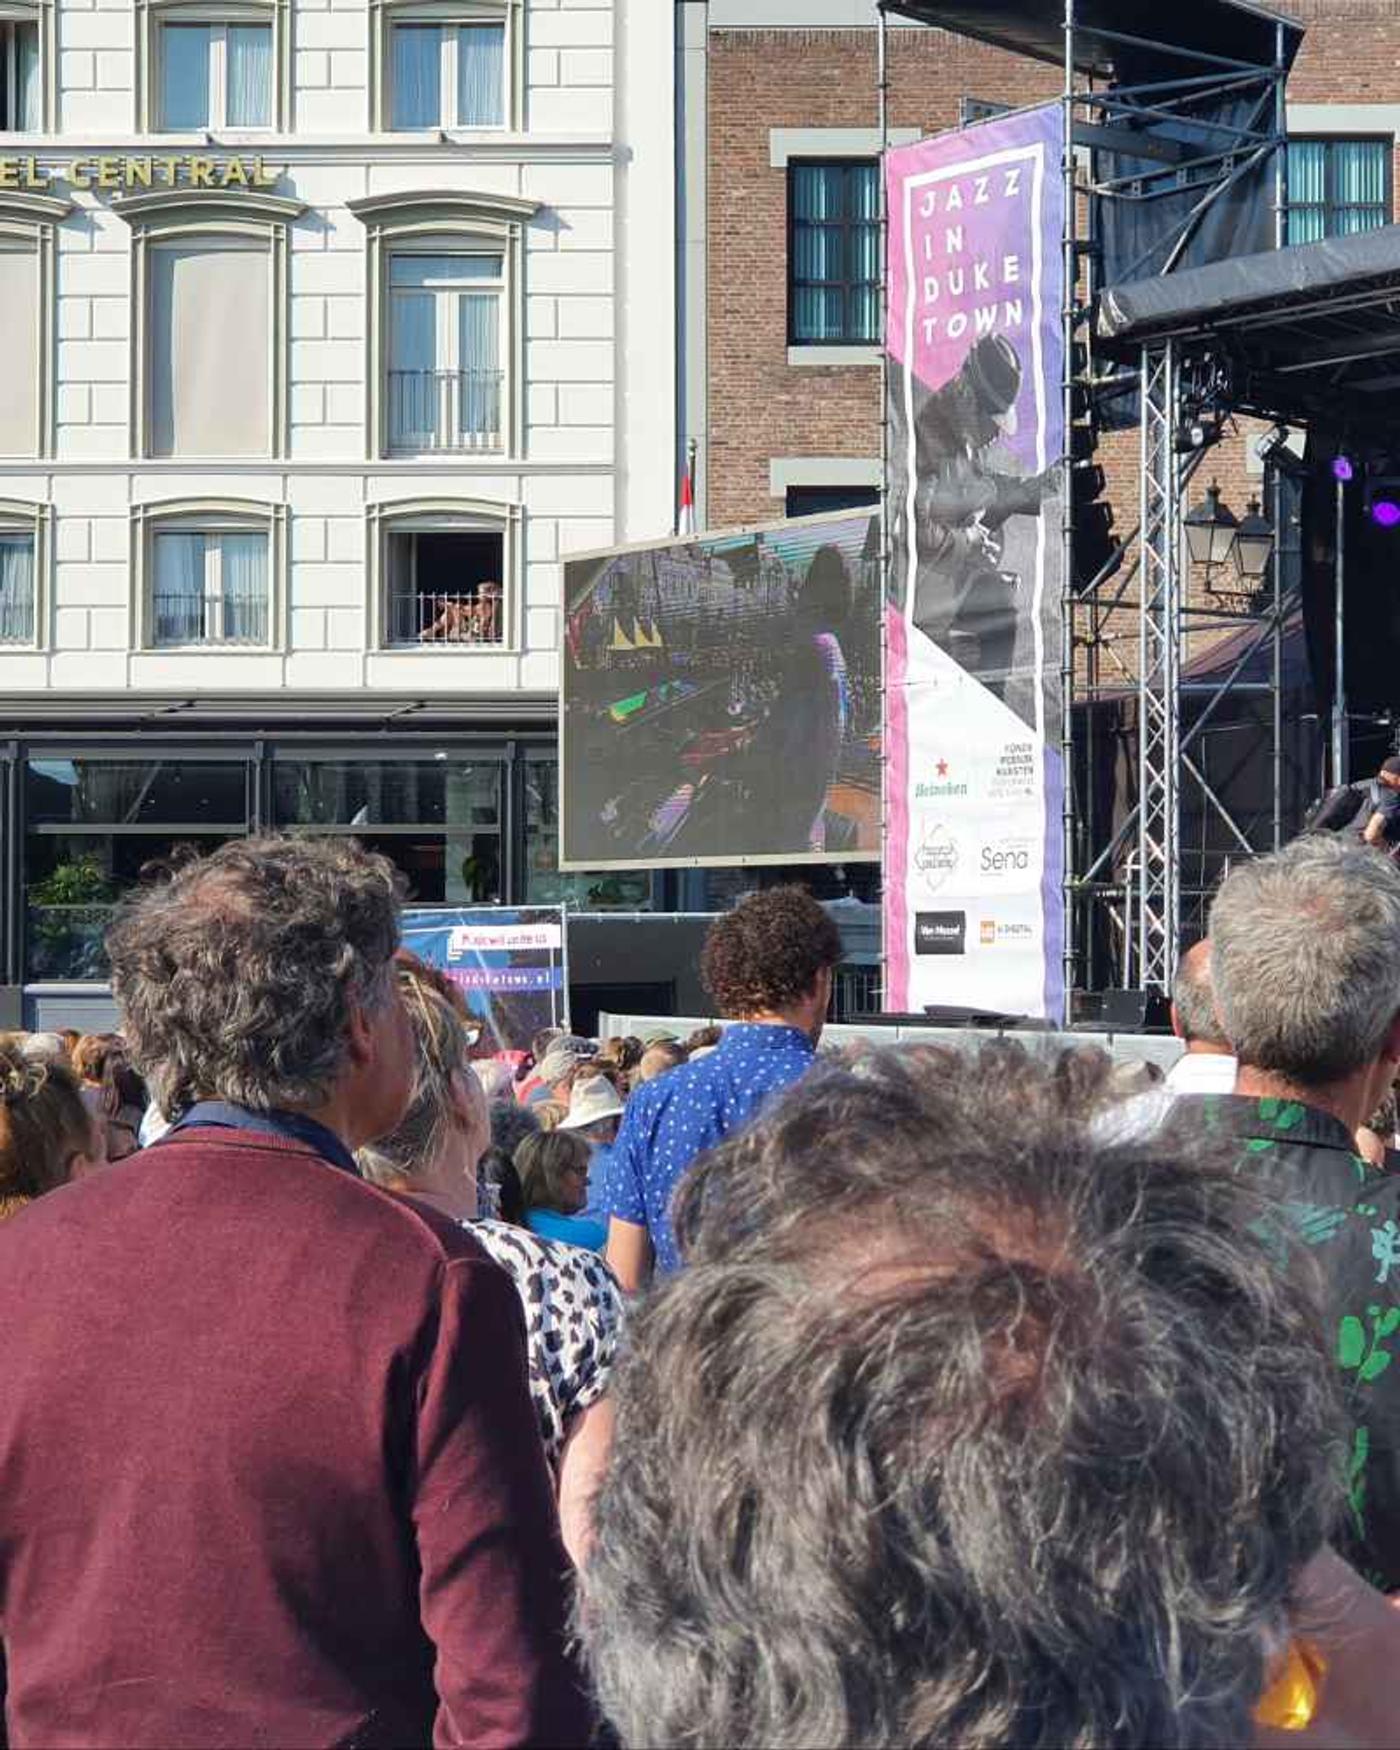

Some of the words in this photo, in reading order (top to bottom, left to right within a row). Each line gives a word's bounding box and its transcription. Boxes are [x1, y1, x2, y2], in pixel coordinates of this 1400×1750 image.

[69, 155, 277, 187] CENTRAL
[920, 168, 1021, 218] JAZZ
[924, 226, 963, 261] IN
[923, 254, 1020, 304] DUKE
[922, 298, 1023, 346] TOWN
[915, 782, 968, 798] Heineken
